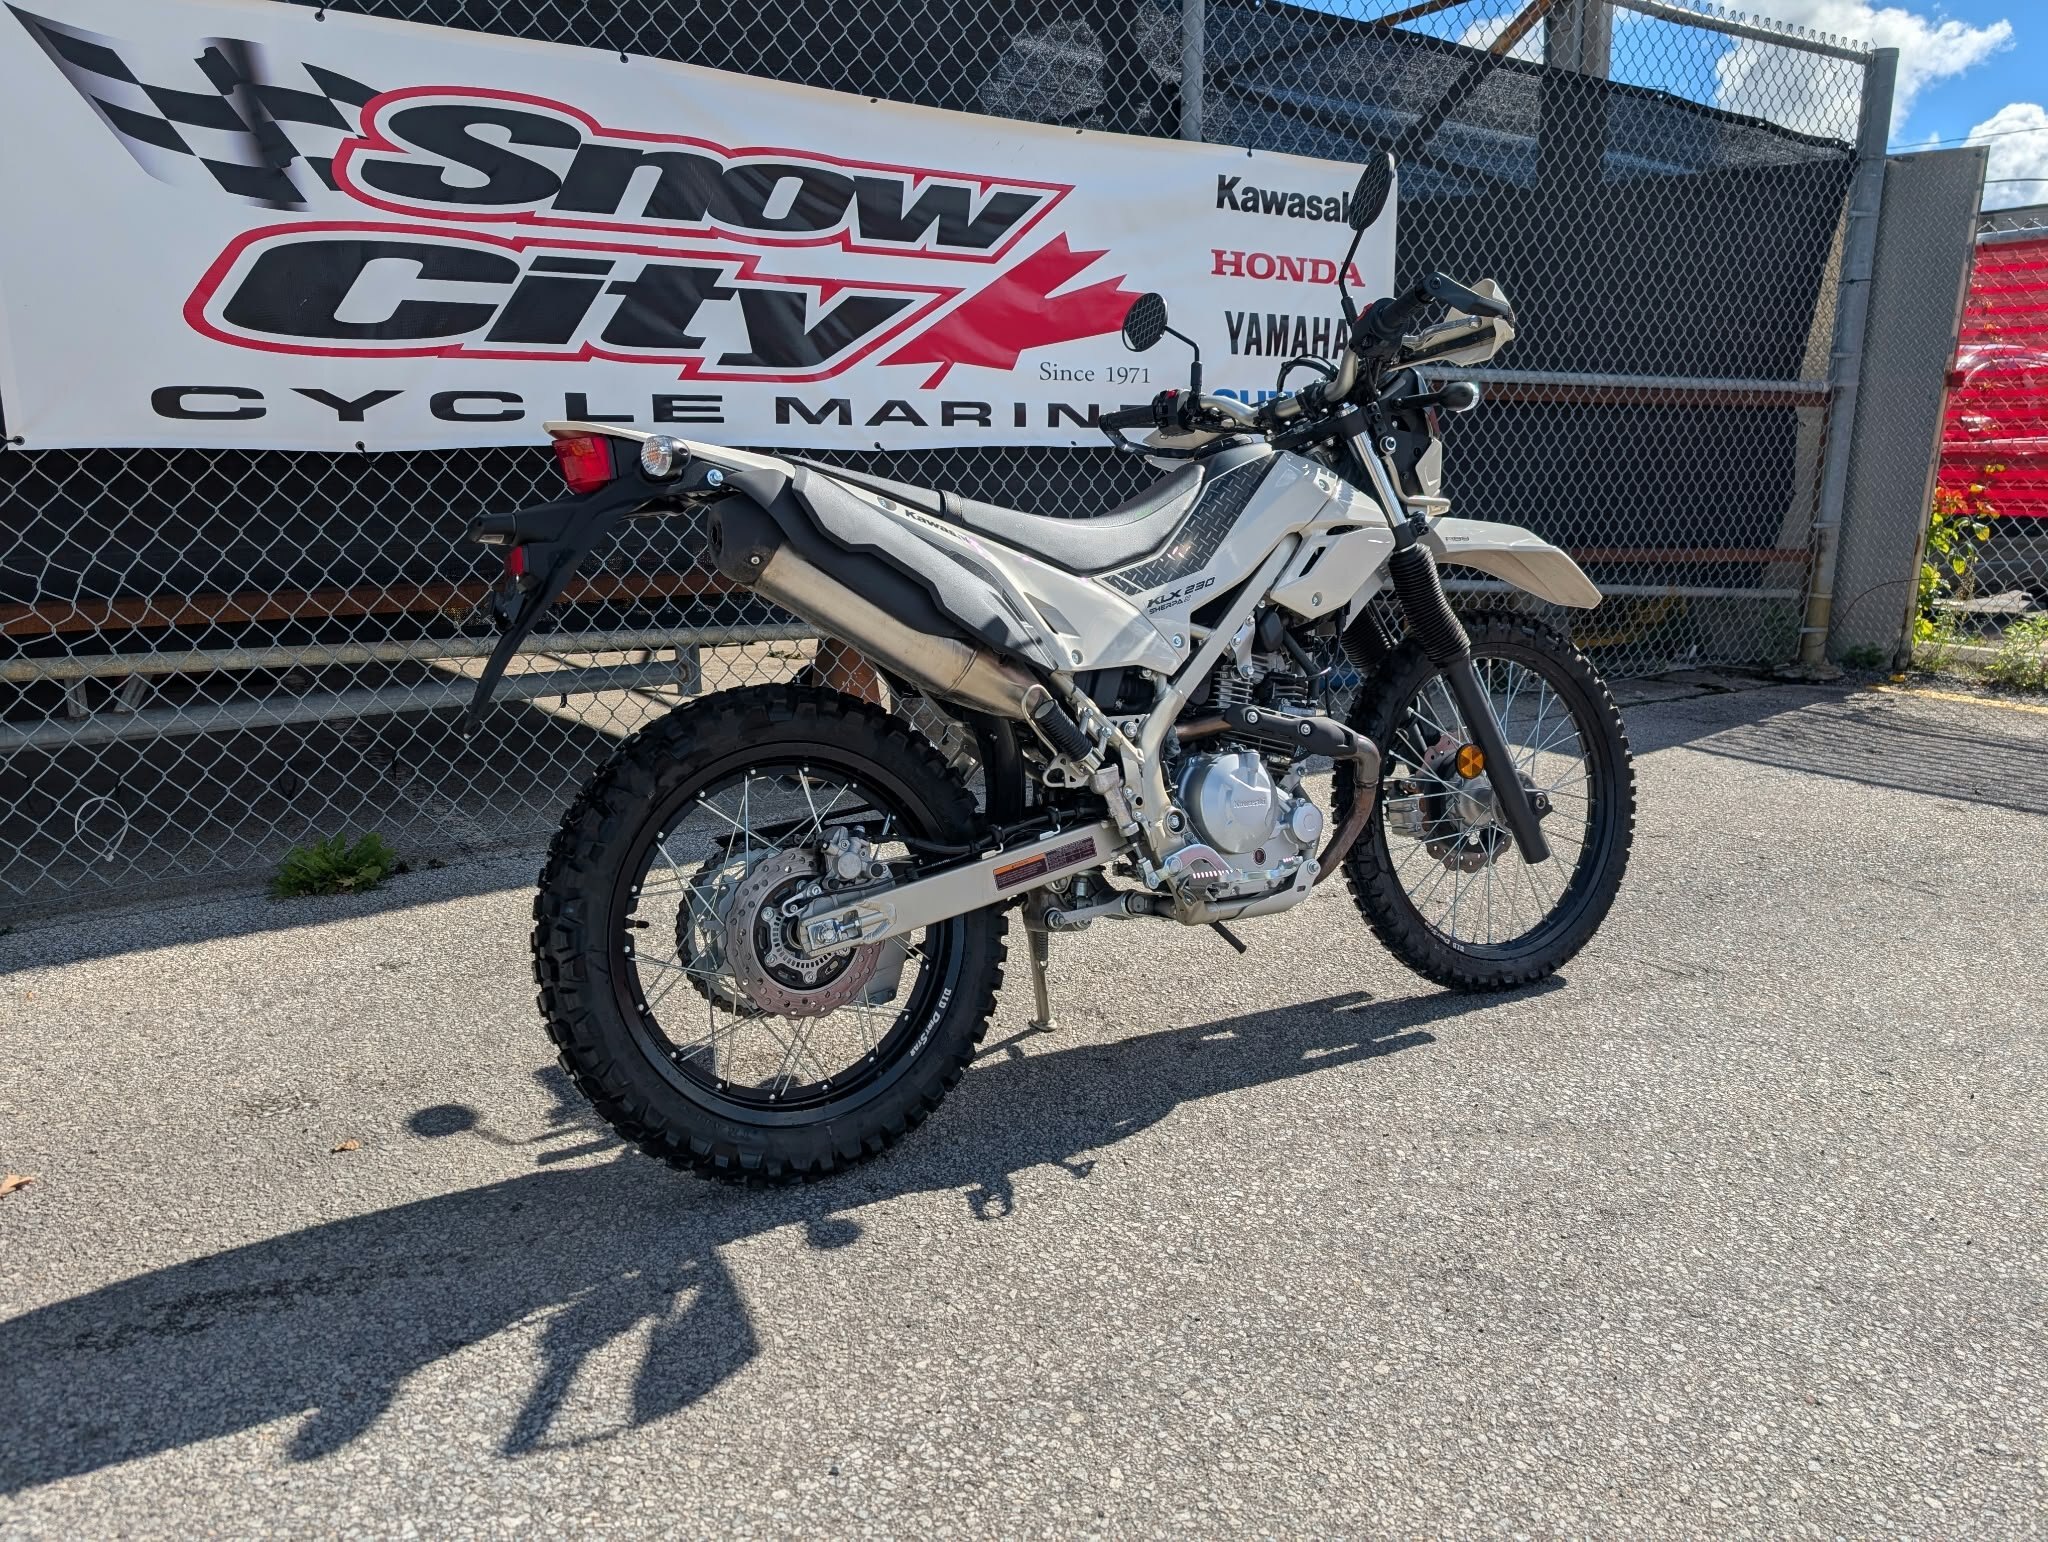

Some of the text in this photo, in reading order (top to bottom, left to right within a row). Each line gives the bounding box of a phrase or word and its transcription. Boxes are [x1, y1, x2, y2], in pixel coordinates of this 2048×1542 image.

[360, 104, 1044, 249] Snow
[1216, 174, 1351, 224] Kawasak
[1211, 249, 1366, 287] HONDA
[223, 240, 917, 368] City
[1224, 311, 1350, 359] YAMAHA
[1039, 361, 1151, 385] Since 1971
[150, 385, 725, 424] CYCLE
[1147, 577, 1216, 608] KLX 230
[1149, 599, 1184, 615] SHERPA
[938, 987, 952, 1009] DID
